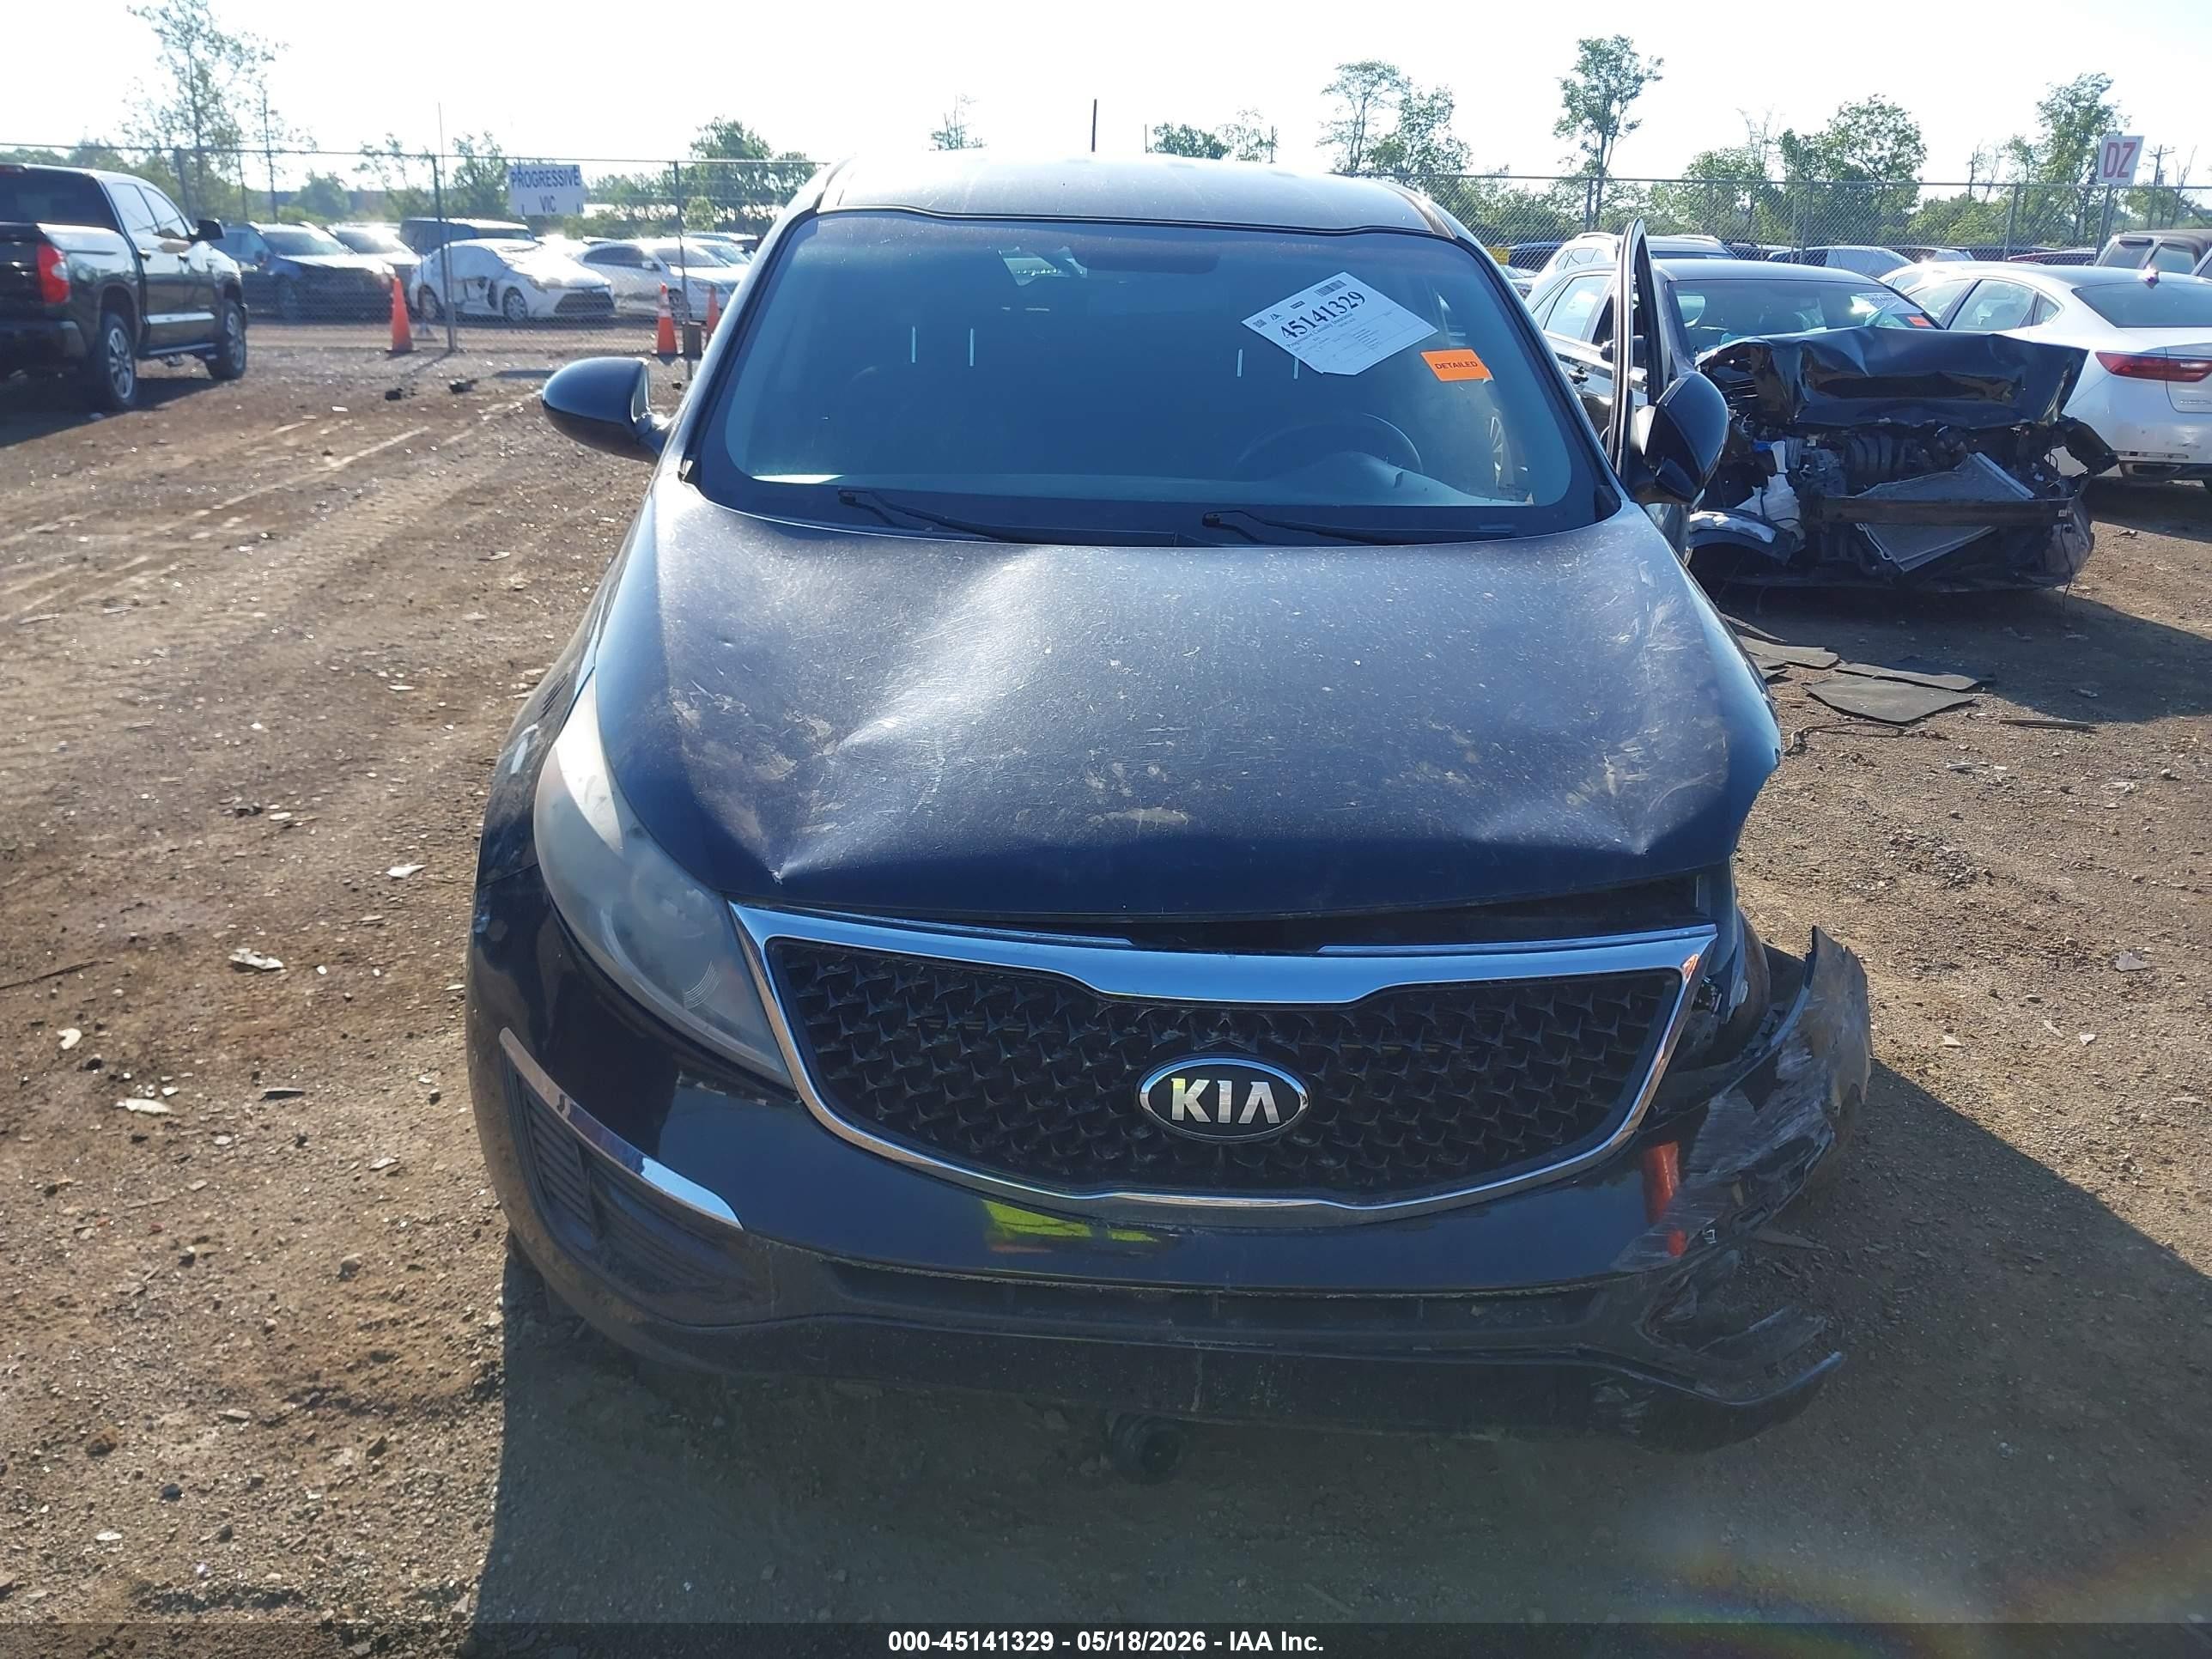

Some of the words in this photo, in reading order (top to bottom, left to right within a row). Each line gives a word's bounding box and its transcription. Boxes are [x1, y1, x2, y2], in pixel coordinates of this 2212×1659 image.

[2104, 142, 2137, 178] DZ
[510, 169, 580, 188] PROGRESSIVE
[538, 194, 556, 213] VIC
[1280, 291, 1365, 338] 45141329
[1434, 361, 1478, 369] DETAILED
[1170, 1078, 1280, 1124] KIA
